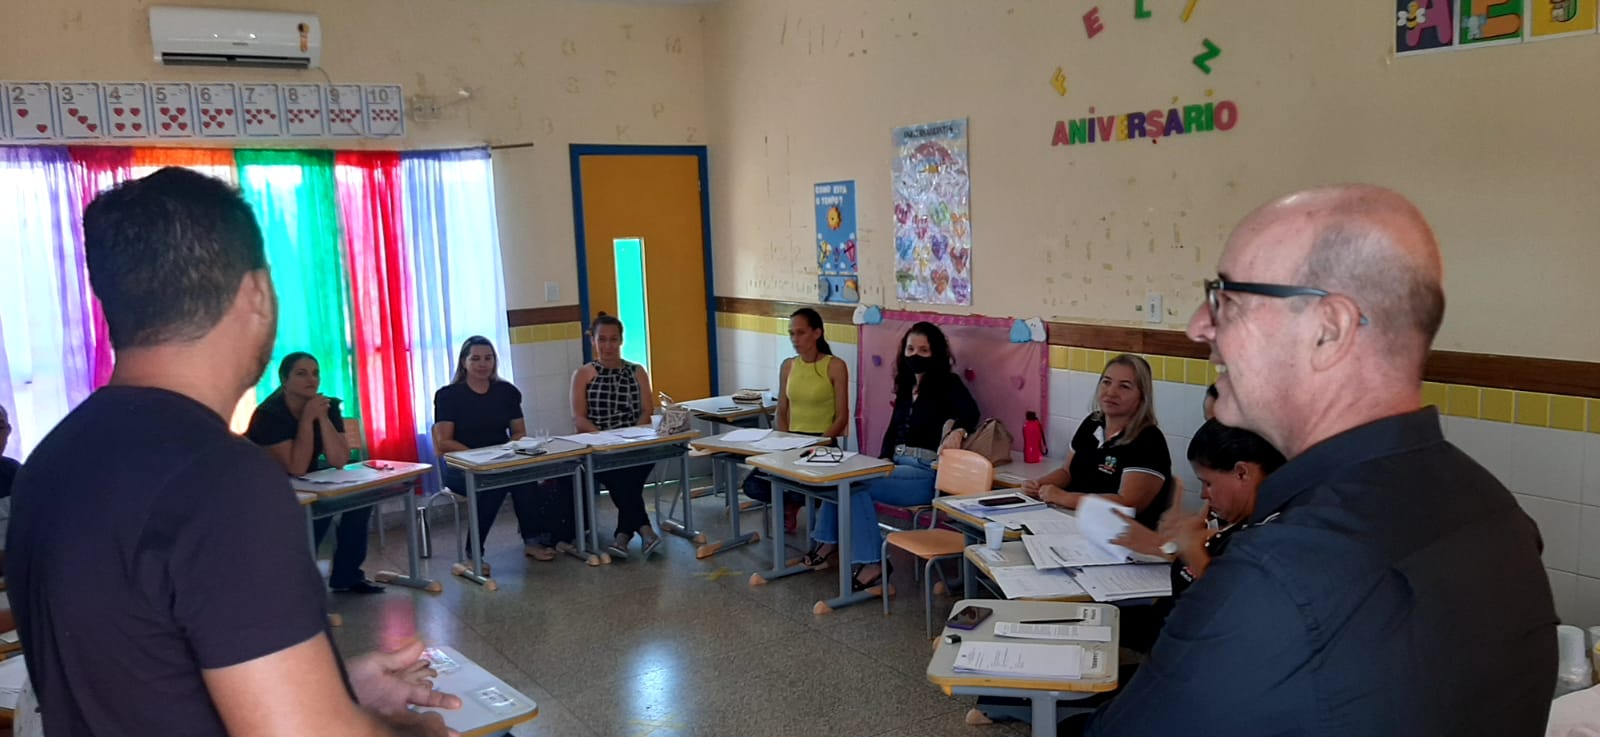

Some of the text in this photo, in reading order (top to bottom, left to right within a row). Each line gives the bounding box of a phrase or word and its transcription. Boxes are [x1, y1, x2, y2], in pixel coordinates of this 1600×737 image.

[11, 86, 25, 102] 2
[61, 87, 74, 102] 3
[108, 87, 122, 101] 4
[155, 87, 167, 102] 5
[200, 87, 212, 102] 6
[245, 87, 256, 102] 7
[288, 87, 299, 102] 8
[329, 88, 340, 103] 9
[368, 89, 389, 103] 10
